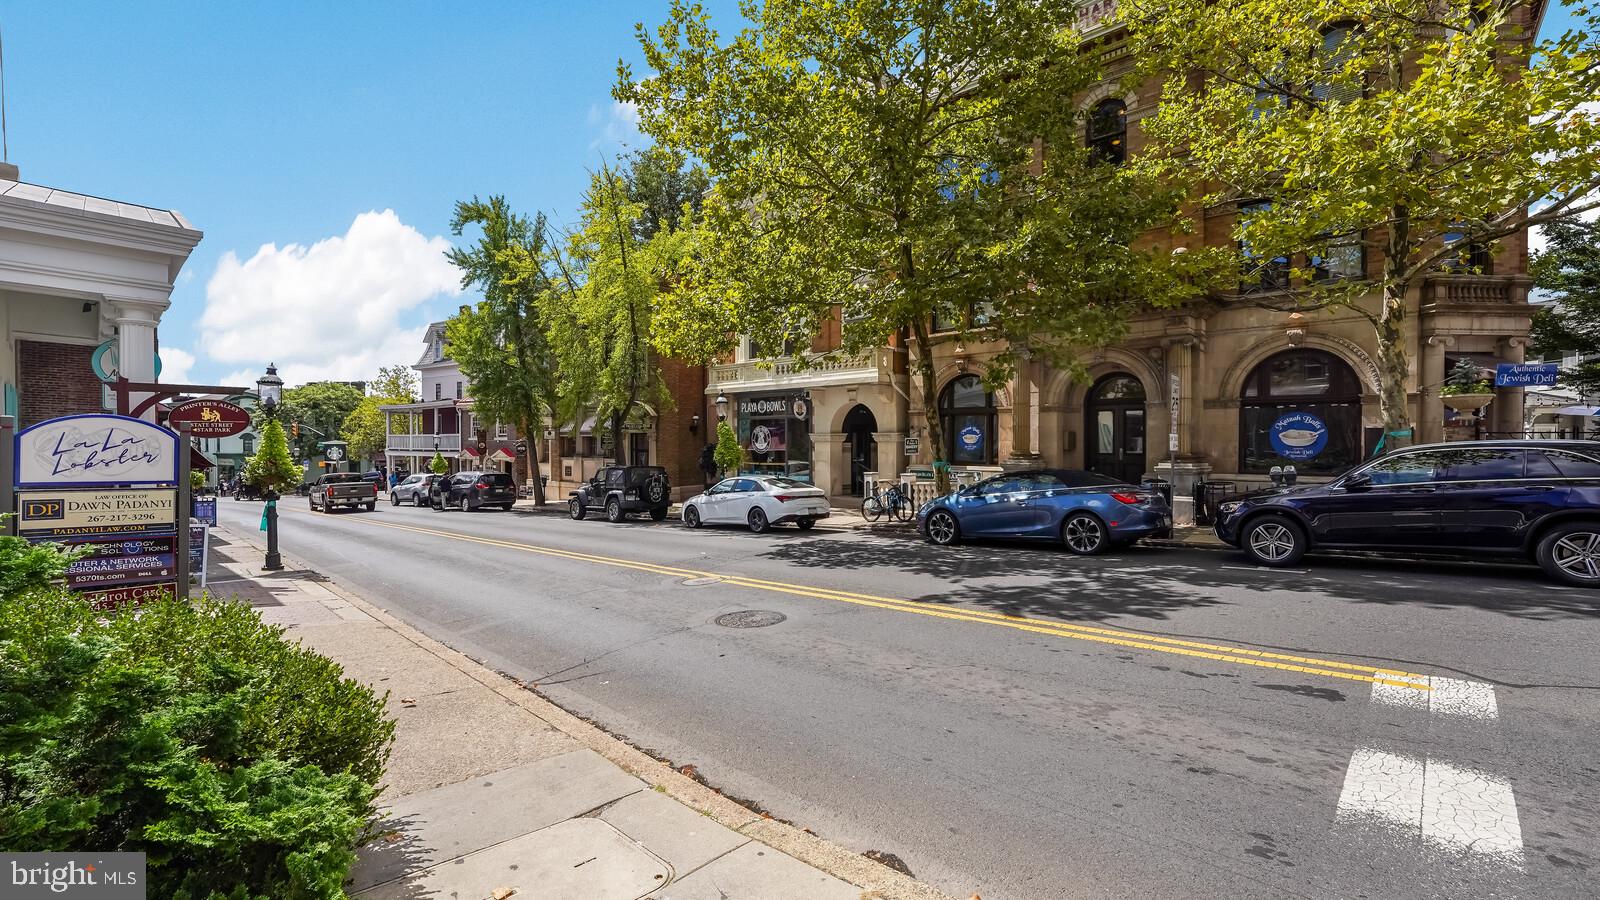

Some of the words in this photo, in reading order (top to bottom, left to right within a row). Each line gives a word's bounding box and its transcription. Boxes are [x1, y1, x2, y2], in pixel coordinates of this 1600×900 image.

[1509, 365, 1546, 374] Authentic
[1498, 374, 1530, 385] Jewish
[1533, 374, 1554, 385] Deli
[180, 401, 218, 412] PRINTER'S
[219, 402, 240, 413] ALLEY
[741, 402, 757, 413] PLAYA
[767, 400, 786, 412] BOWLS
[1274, 415, 1301, 430] Matzah
[1302, 415, 1321, 429] Balls
[52, 448, 159, 476] Lobster
[28, 503, 60, 516] DP
[68, 501, 112, 511] DAWN
[116, 499, 172, 510] PADANYI
[87, 513, 155, 523] 267-217-3296
[53, 525, 146, 535] PADANYILAW.COM
[64, 563, 114, 574] ESSIONAL
[116, 561, 163, 570] SERVICES
[70, 559, 98, 568] UTER
[110, 556, 159, 565] NETWORK
[76, 573, 125, 582] 5370ts.com
